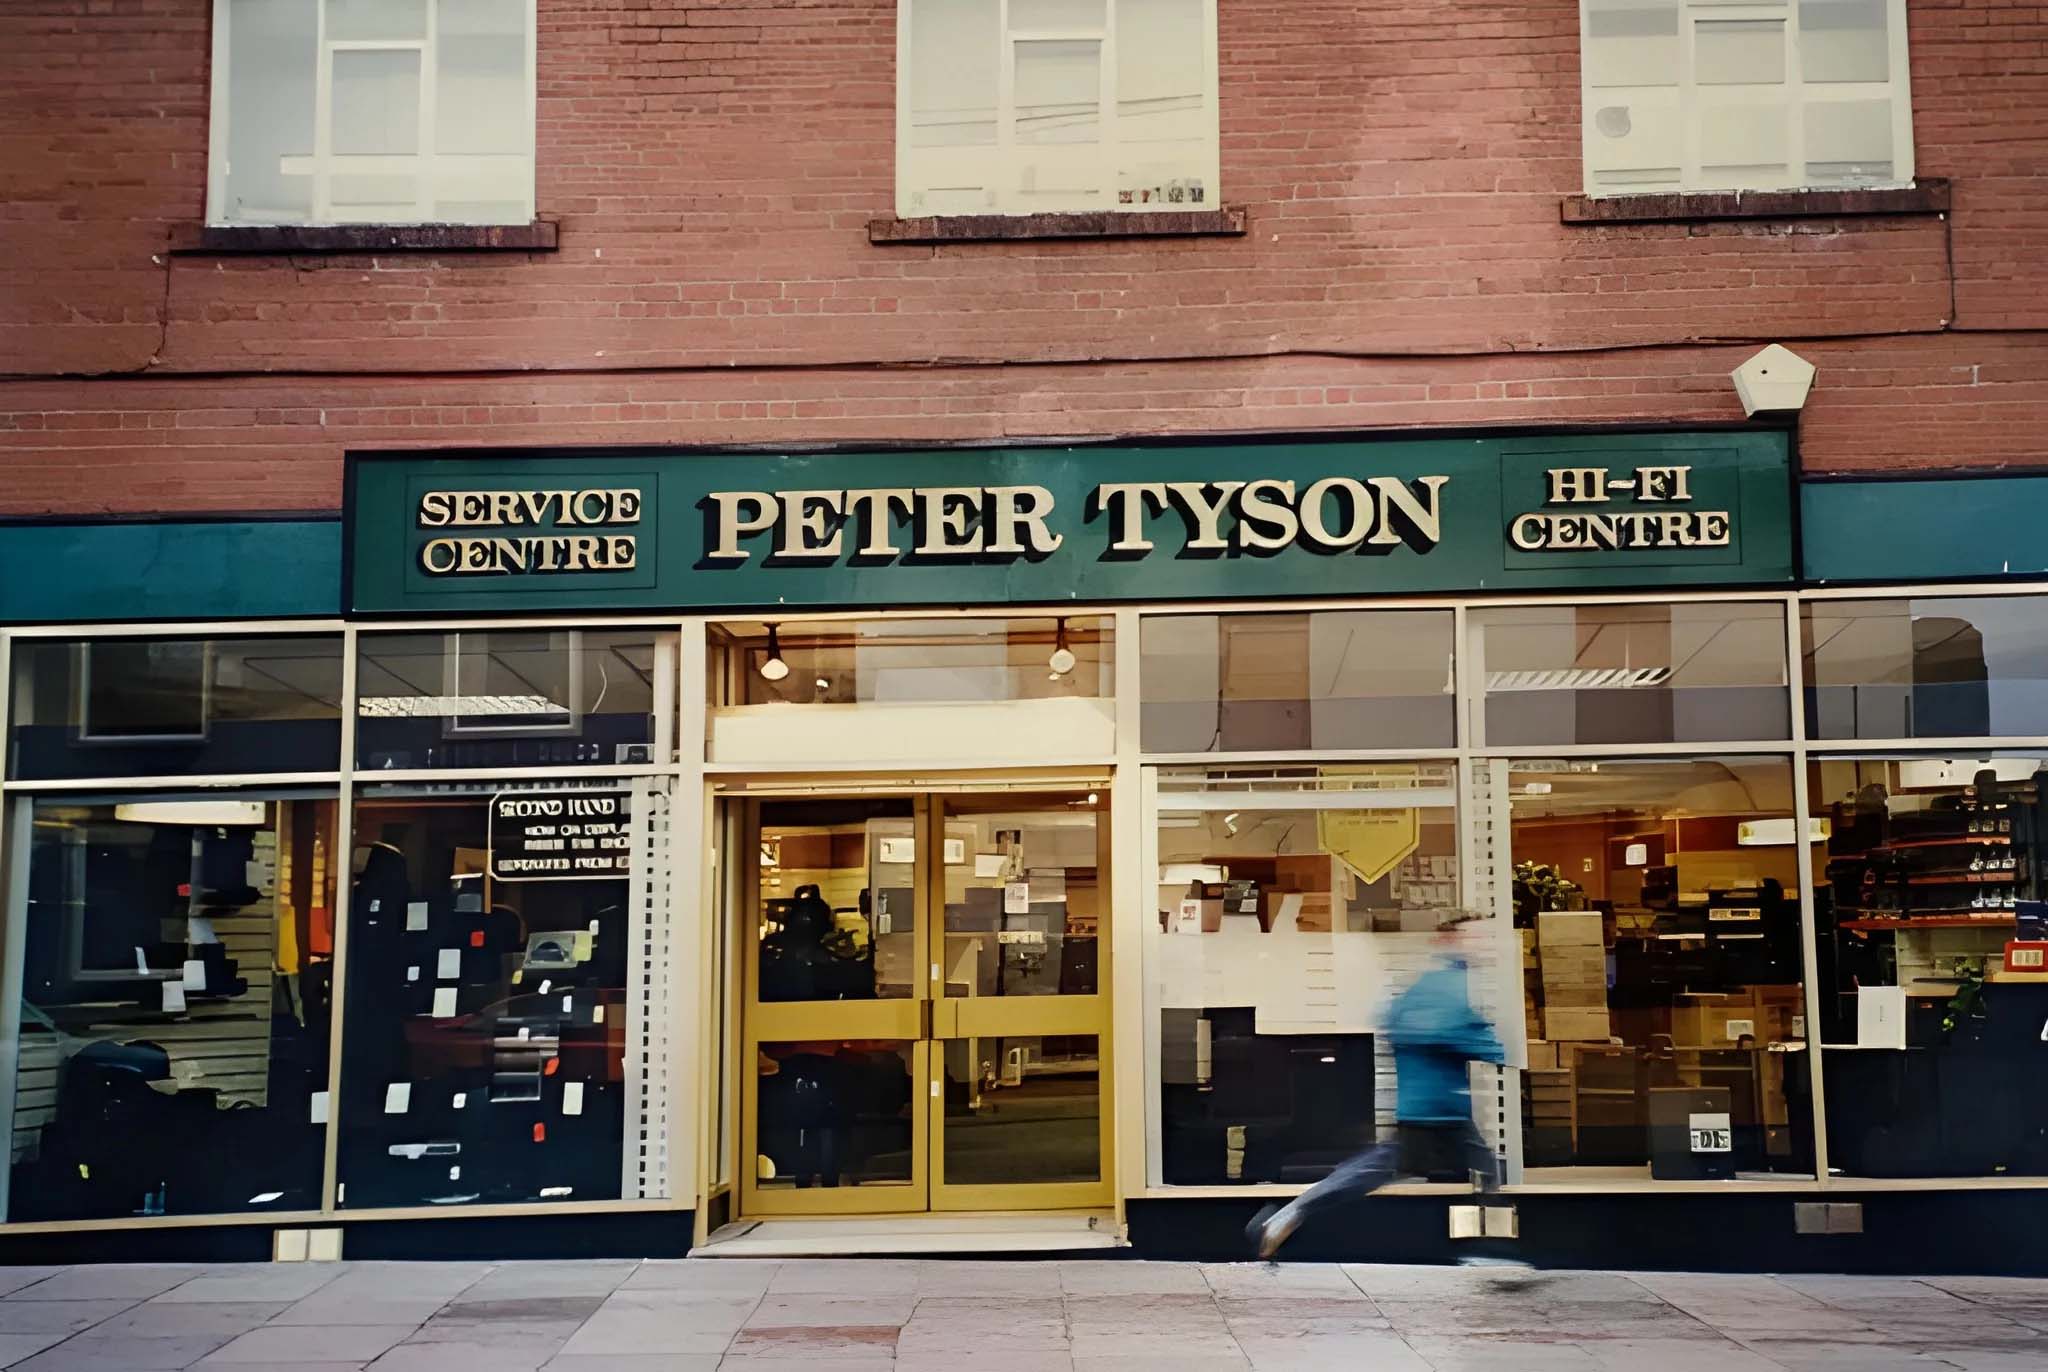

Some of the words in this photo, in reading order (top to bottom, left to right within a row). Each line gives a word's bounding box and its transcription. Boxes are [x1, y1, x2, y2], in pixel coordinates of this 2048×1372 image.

[1547, 466, 1692, 503] HI-FI
[420, 489, 641, 526] SERVICE
[703, 485, 1063, 562] PETER
[1096, 475, 1450, 553] TYSON
[1511, 511, 1730, 550] CENTRE
[422, 535, 636, 574] CENTRE
